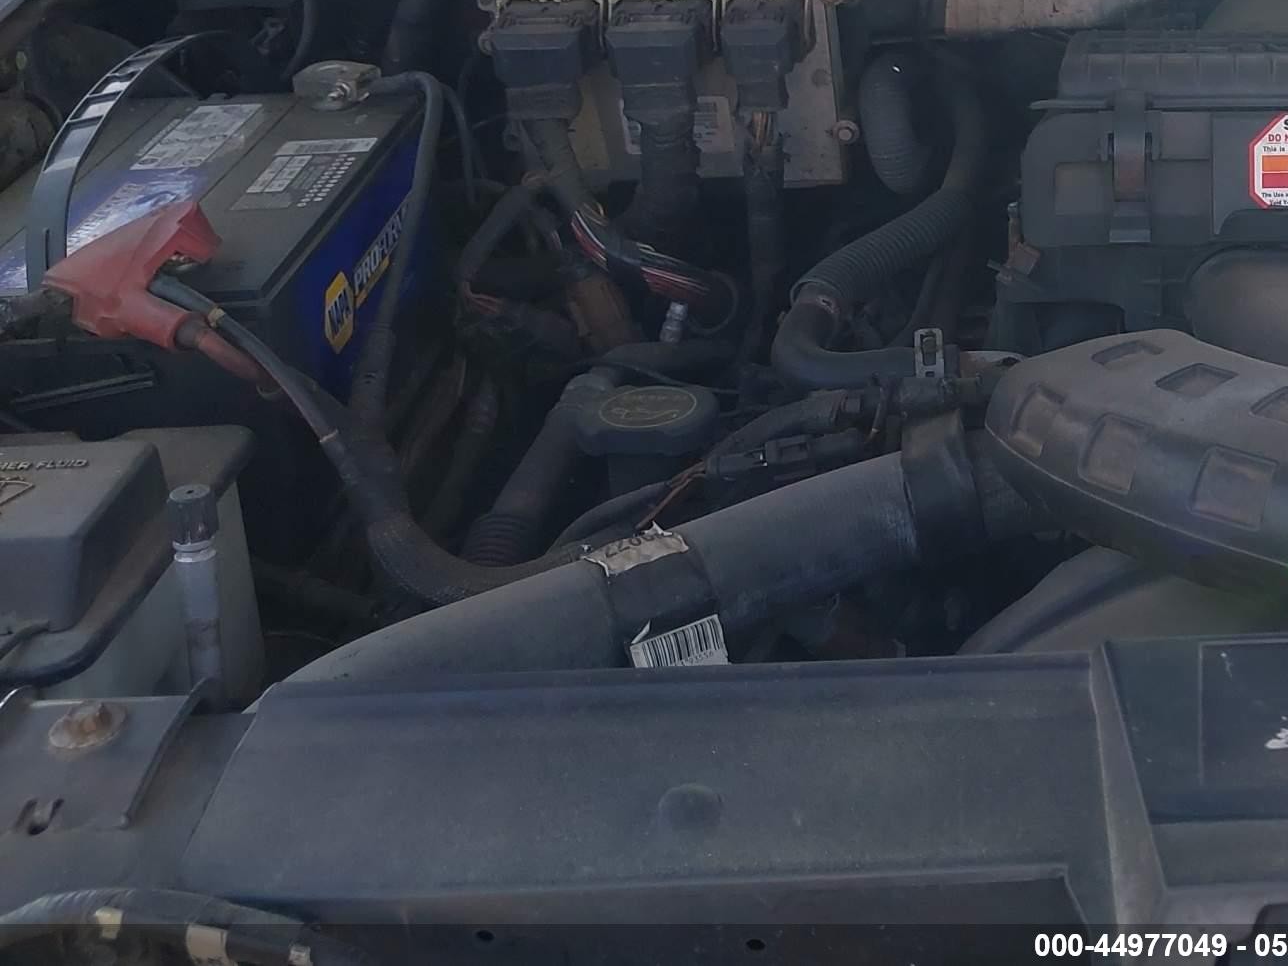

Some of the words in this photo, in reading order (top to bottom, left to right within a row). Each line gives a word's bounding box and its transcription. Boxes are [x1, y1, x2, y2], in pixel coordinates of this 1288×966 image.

[1268, 134, 1282, 142] DO
[328, 288, 351, 335] NAPA
[36, 458, 87, 469] FLUID
